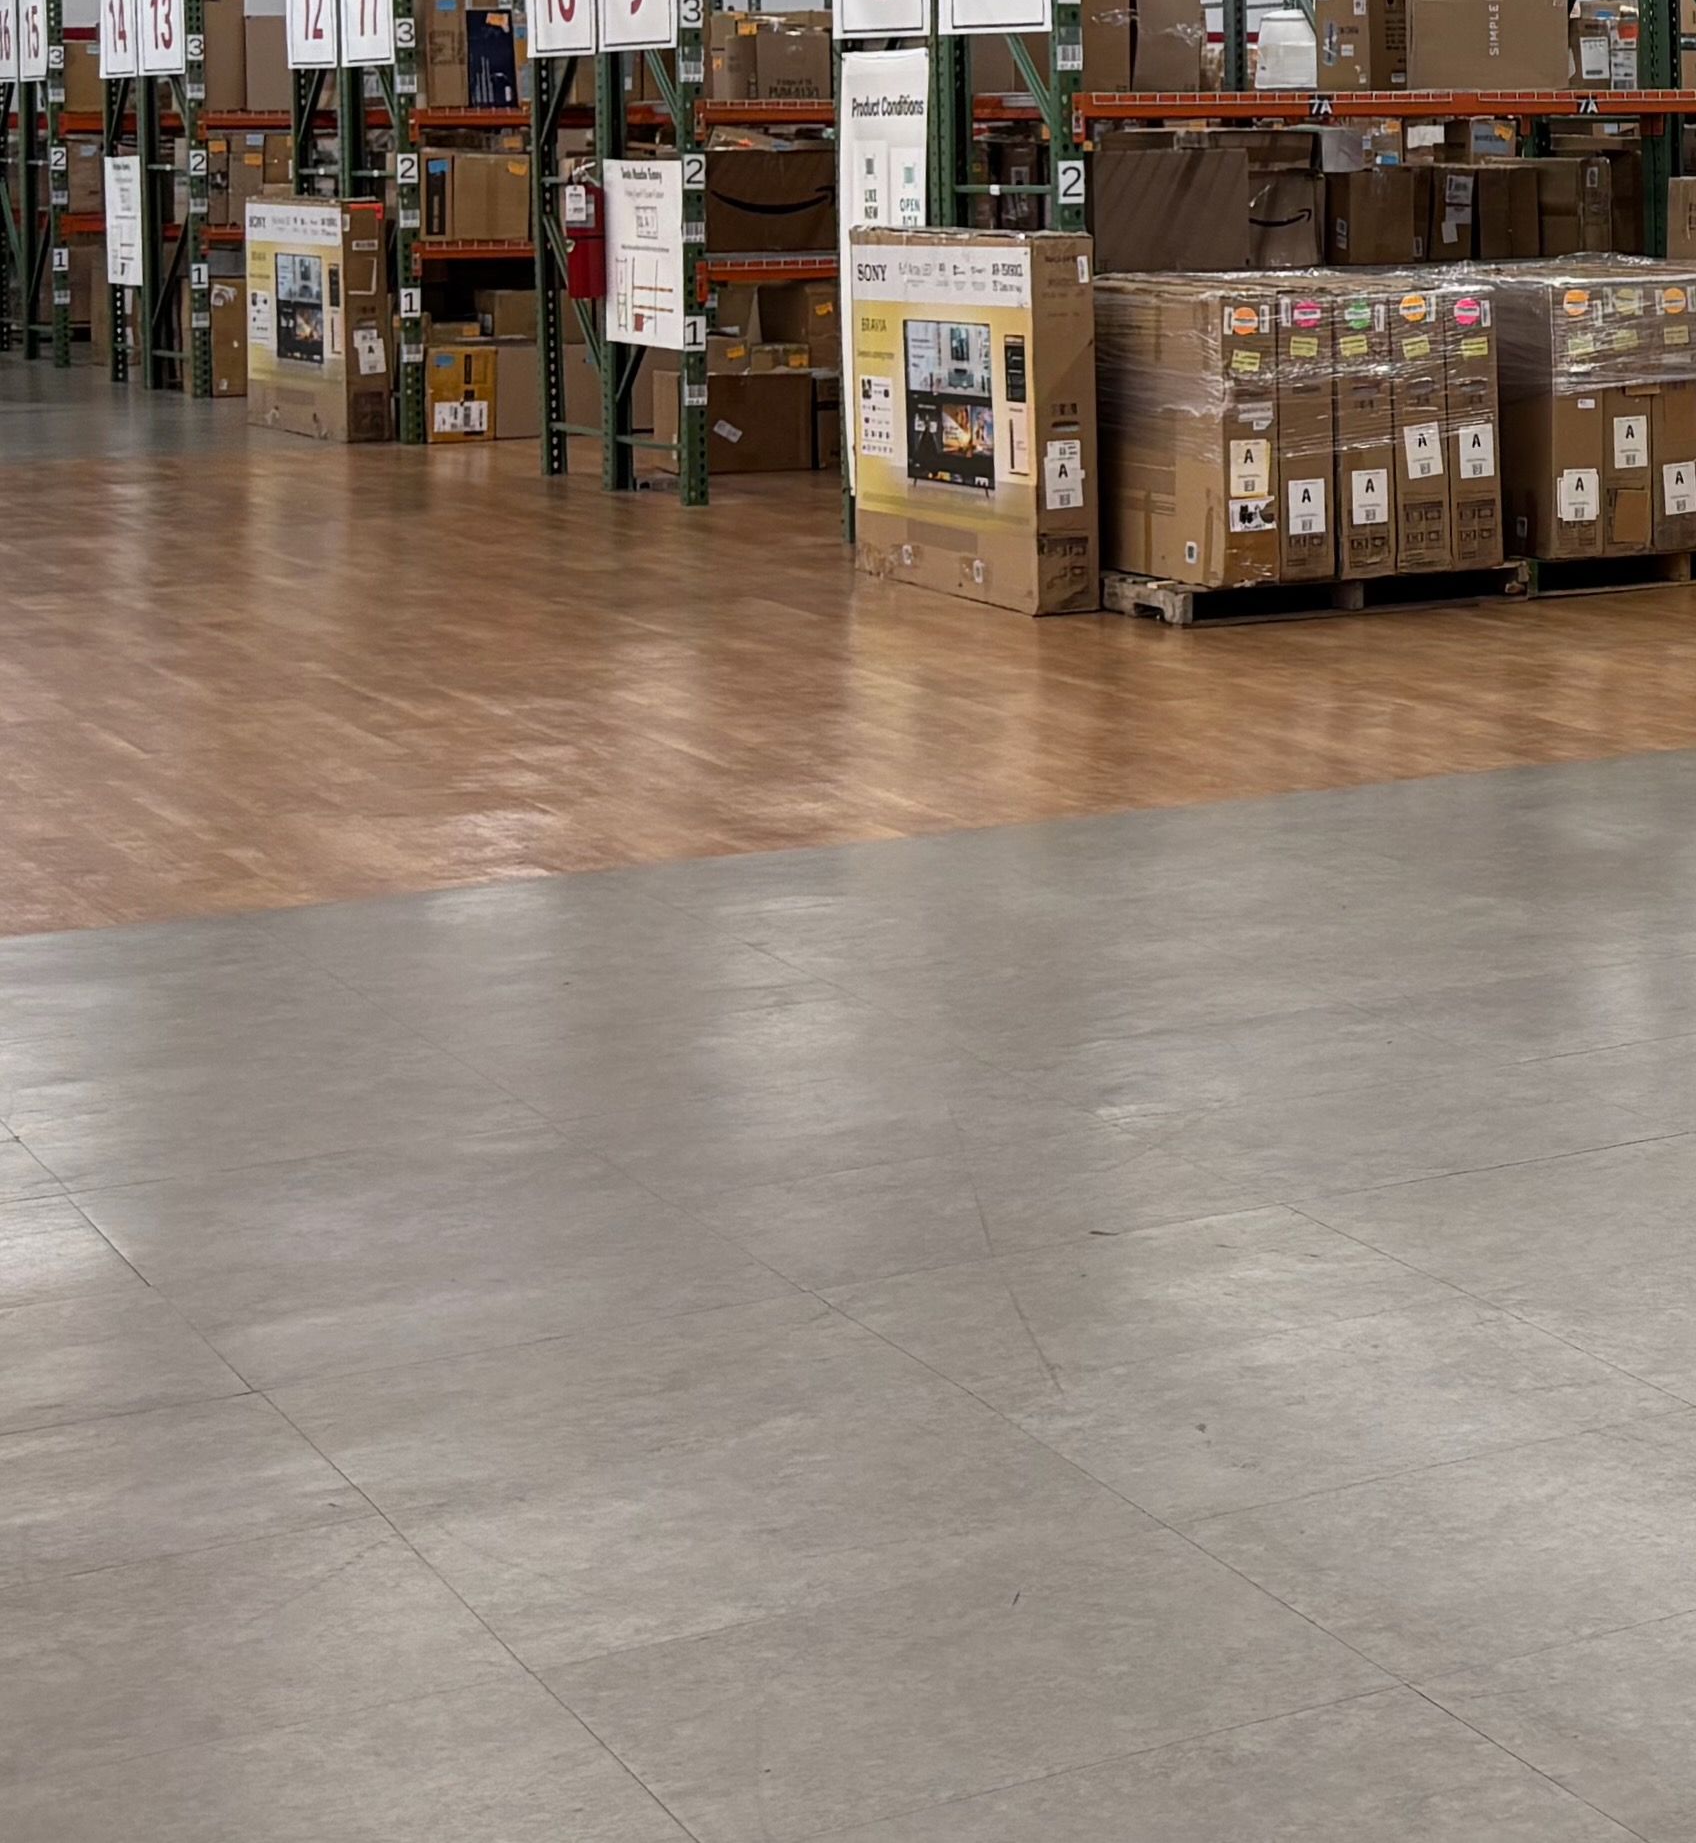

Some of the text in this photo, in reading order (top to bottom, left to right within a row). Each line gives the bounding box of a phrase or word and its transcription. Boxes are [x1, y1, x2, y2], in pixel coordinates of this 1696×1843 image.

[26, 5, 39, 58] 15
[397, 21, 414, 42] 3
[1488, 4, 1500, 56] SIMPLE
[188, 37, 203, 57] 3
[51, 48, 63, 65] 3
[851, 94, 924, 118] Product Conditions
[1310, 98, 1332, 114] 7A
[1580, 99, 1599, 114] 7A
[53, 150, 65, 168] 2
[191, 152, 205, 173] 2
[401, 158, 418, 179] 2
[685, 158, 704, 185] 2
[1061, 166, 1083, 198] 2
[900, 197, 920, 213] OPEN
[55, 253, 66, 270] 1
[194, 267, 206, 284] 1
[857, 262, 887, 282] SONY
[404, 292, 418, 313] 1
[686, 320, 704, 346] 1
[861, 318, 887, 333] BRAVIA
[1624, 424, 1635, 439] A
[1417, 433, 1428, 448] A
[1471, 433, 1481, 448] A
[1243, 448, 1254, 464] A
[1057, 463, 1068, 479] A
[1674, 470, 1684, 485] A
[1364, 477, 1375, 493] A
[1574, 476, 1585, 492] A
[1301, 487, 1312, 503] A
